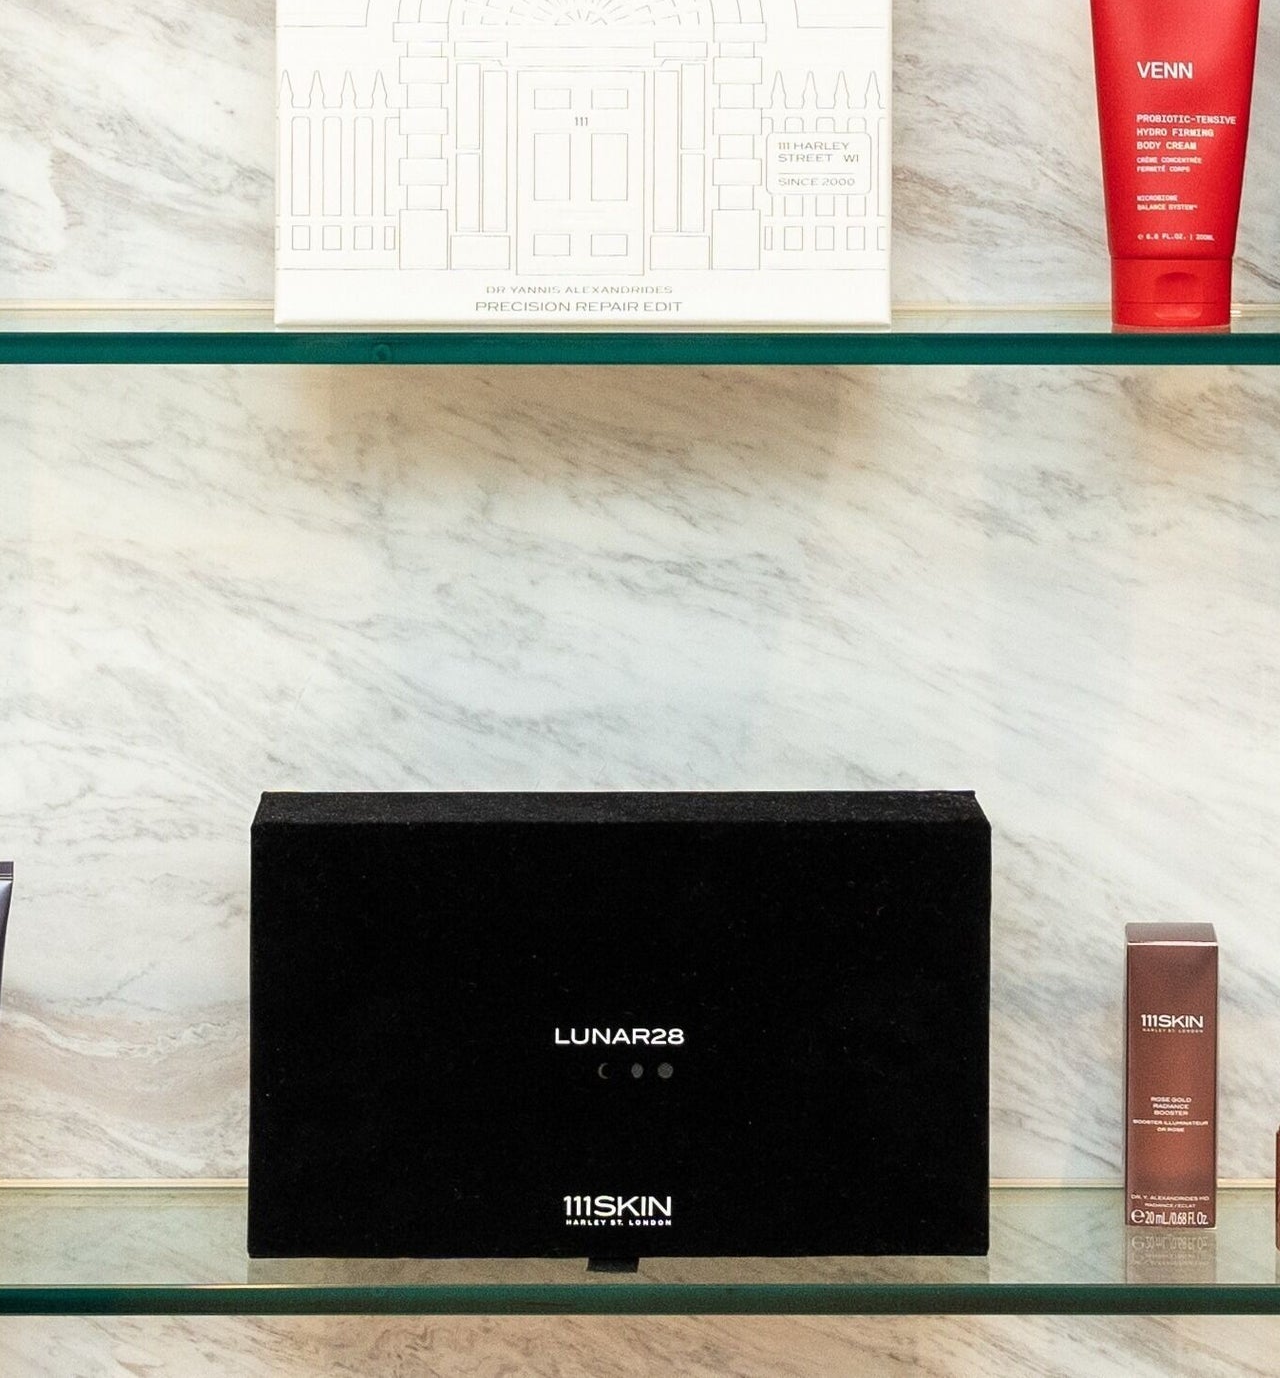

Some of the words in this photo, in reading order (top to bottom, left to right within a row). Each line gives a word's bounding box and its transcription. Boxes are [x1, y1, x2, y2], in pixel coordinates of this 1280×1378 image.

[1136, 61, 1193, 79] VENN
[1136, 114, 1237, 125] PROBIOTIC-TENSIVE
[1136, 128, 1168, 137] HYDRO
[1172, 128, 1215, 137] FIRMING
[793, 141, 850, 150] HARLEY
[1137, 141, 1161, 150] BODY
[1165, 141, 1197, 150] CREAM
[778, 153, 833, 163] STREET
[778, 178, 819, 186] SINCE
[821, 177, 855, 186] 2000
[486, 285, 506, 294] DR
[511, 285, 561, 294] YANNIS
[565, 285, 673, 294] ALEXANDRIDES
[475, 301, 571, 312] PRECISION
[576, 301, 640, 312] REPAIR
[643, 301, 683, 312] EDIT
[1140, 1014, 1204, 1028] 111SKIN
[554, 1027, 685, 1045] LUNAR28
[563, 1195, 672, 1217] 111SKIN
